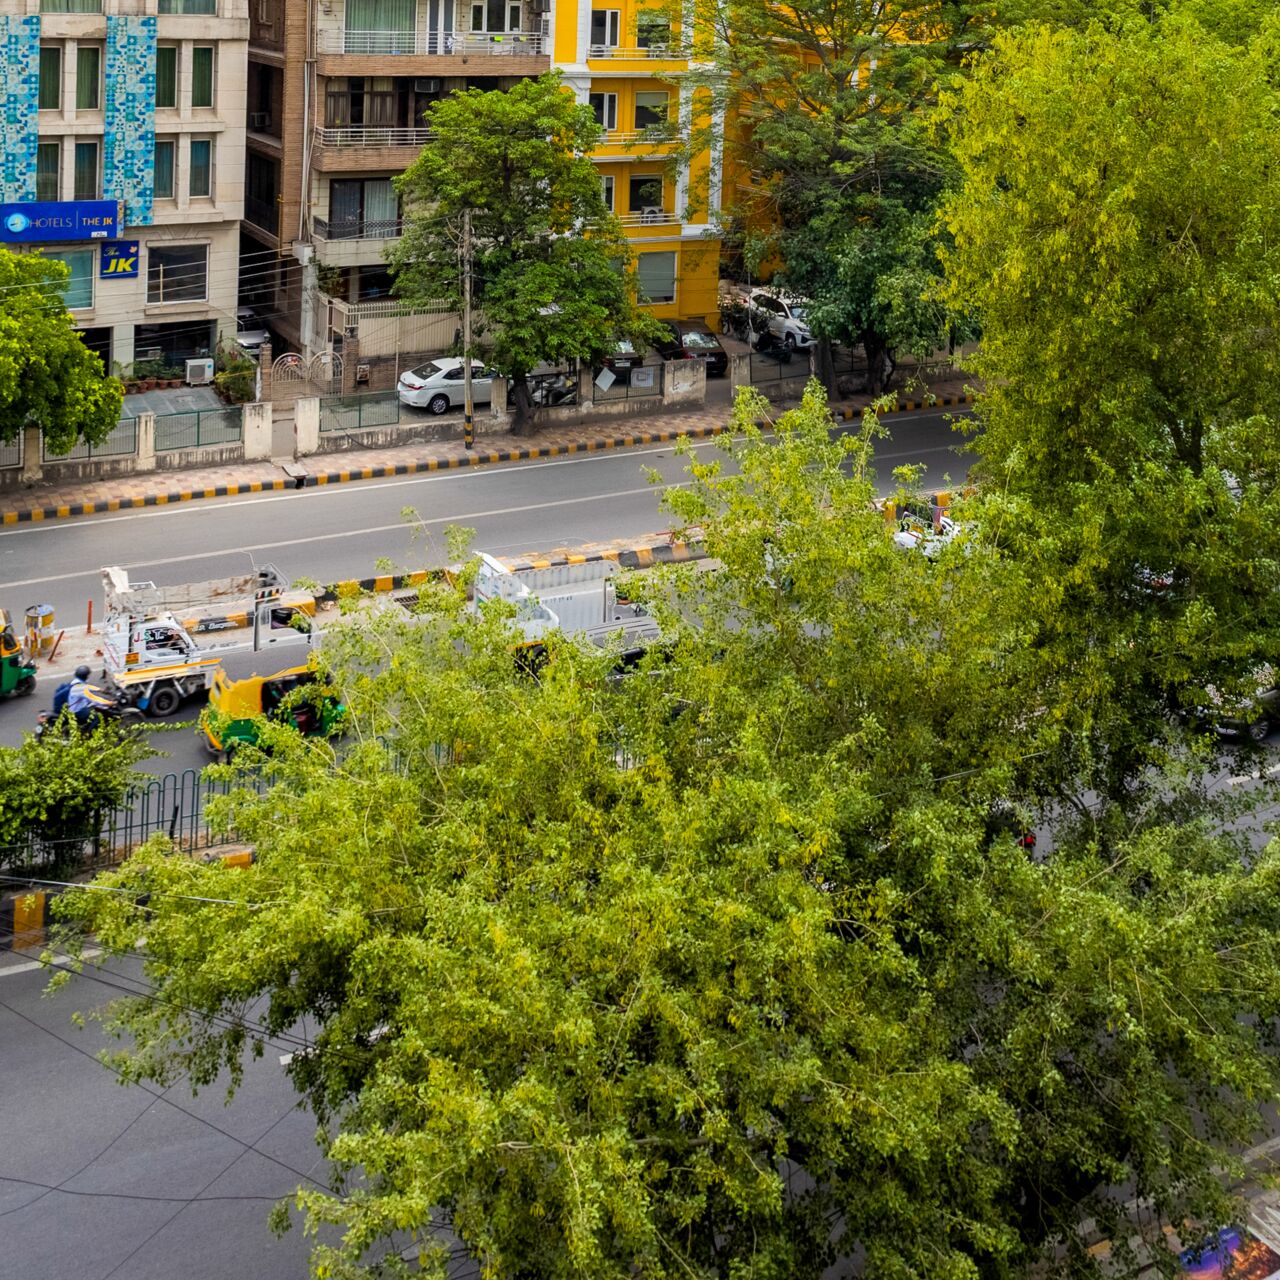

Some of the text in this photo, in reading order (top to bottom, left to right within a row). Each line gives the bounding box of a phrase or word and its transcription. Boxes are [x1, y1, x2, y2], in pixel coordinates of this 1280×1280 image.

[29, 216, 113, 228] HOTELS THE JK
[102, 257, 137, 273] JK
